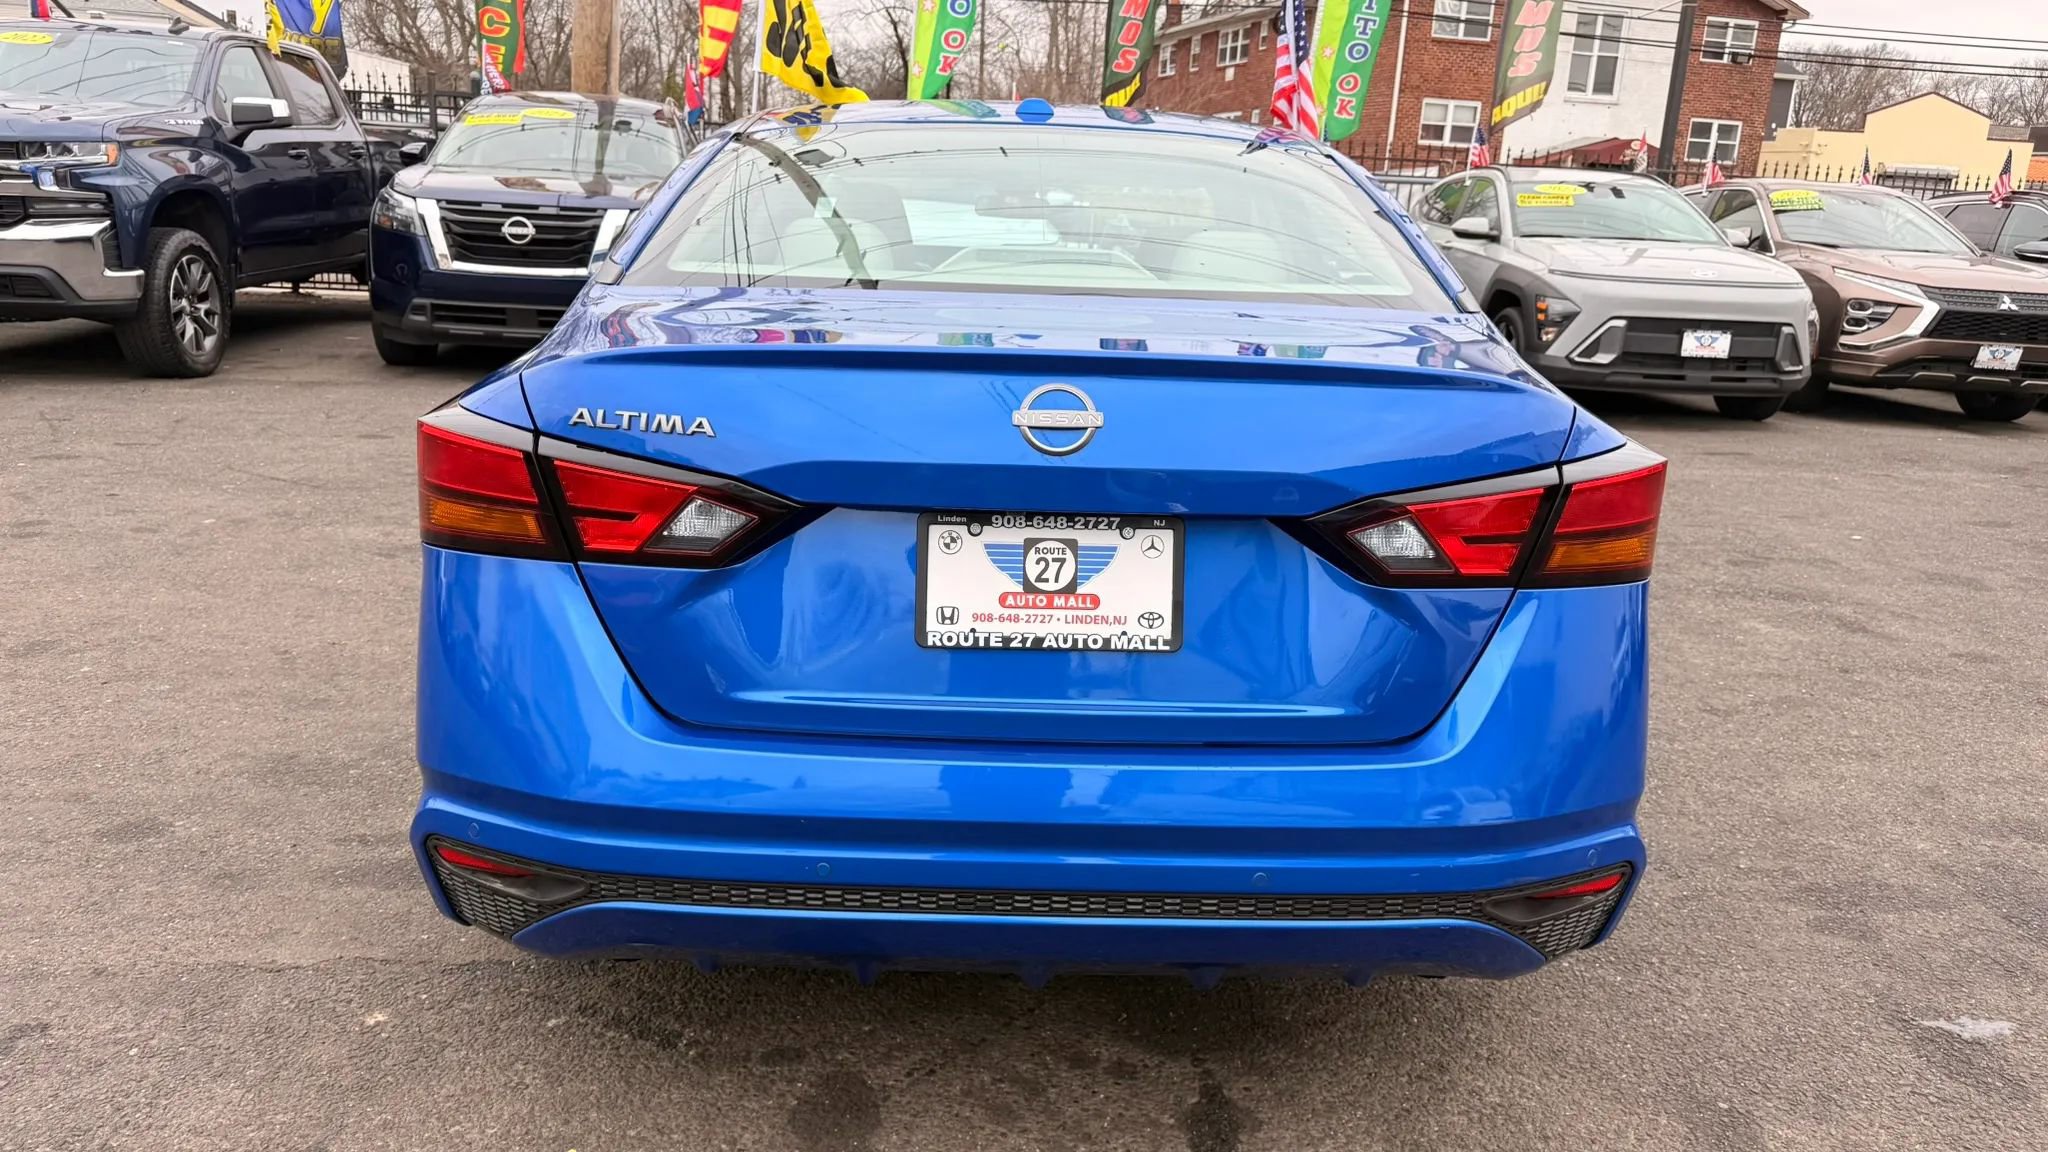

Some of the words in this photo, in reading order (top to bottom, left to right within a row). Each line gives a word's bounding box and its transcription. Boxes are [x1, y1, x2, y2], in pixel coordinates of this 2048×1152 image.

[936, 28, 967, 76] OK
[1334, 72, 1361, 119] OK
[568, 407, 717, 437] ALTIMA
[1014, 412, 1101, 425] NISSAN
[937, 515, 967, 523] Linden
[991, 514, 1121, 531] 908-648-2727
[1153, 519, 1166, 527] NJ
[1034, 546, 1067, 556] ROUTE
[1034, 557, 1067, 584] 27
[1005, 594, 1049, 607] AUTO
[1052, 595, 1095, 608] MALL
[972, 612, 1054, 625] 908-648-2727
[1064, 615, 1128, 626] LINDEN,NJ
[927, 630, 1003, 647] ROUTE
[1006, 632, 1036, 648] 27
[1041, 633, 1110, 649] AUTO
[1111, 634, 1171, 650] MALL
